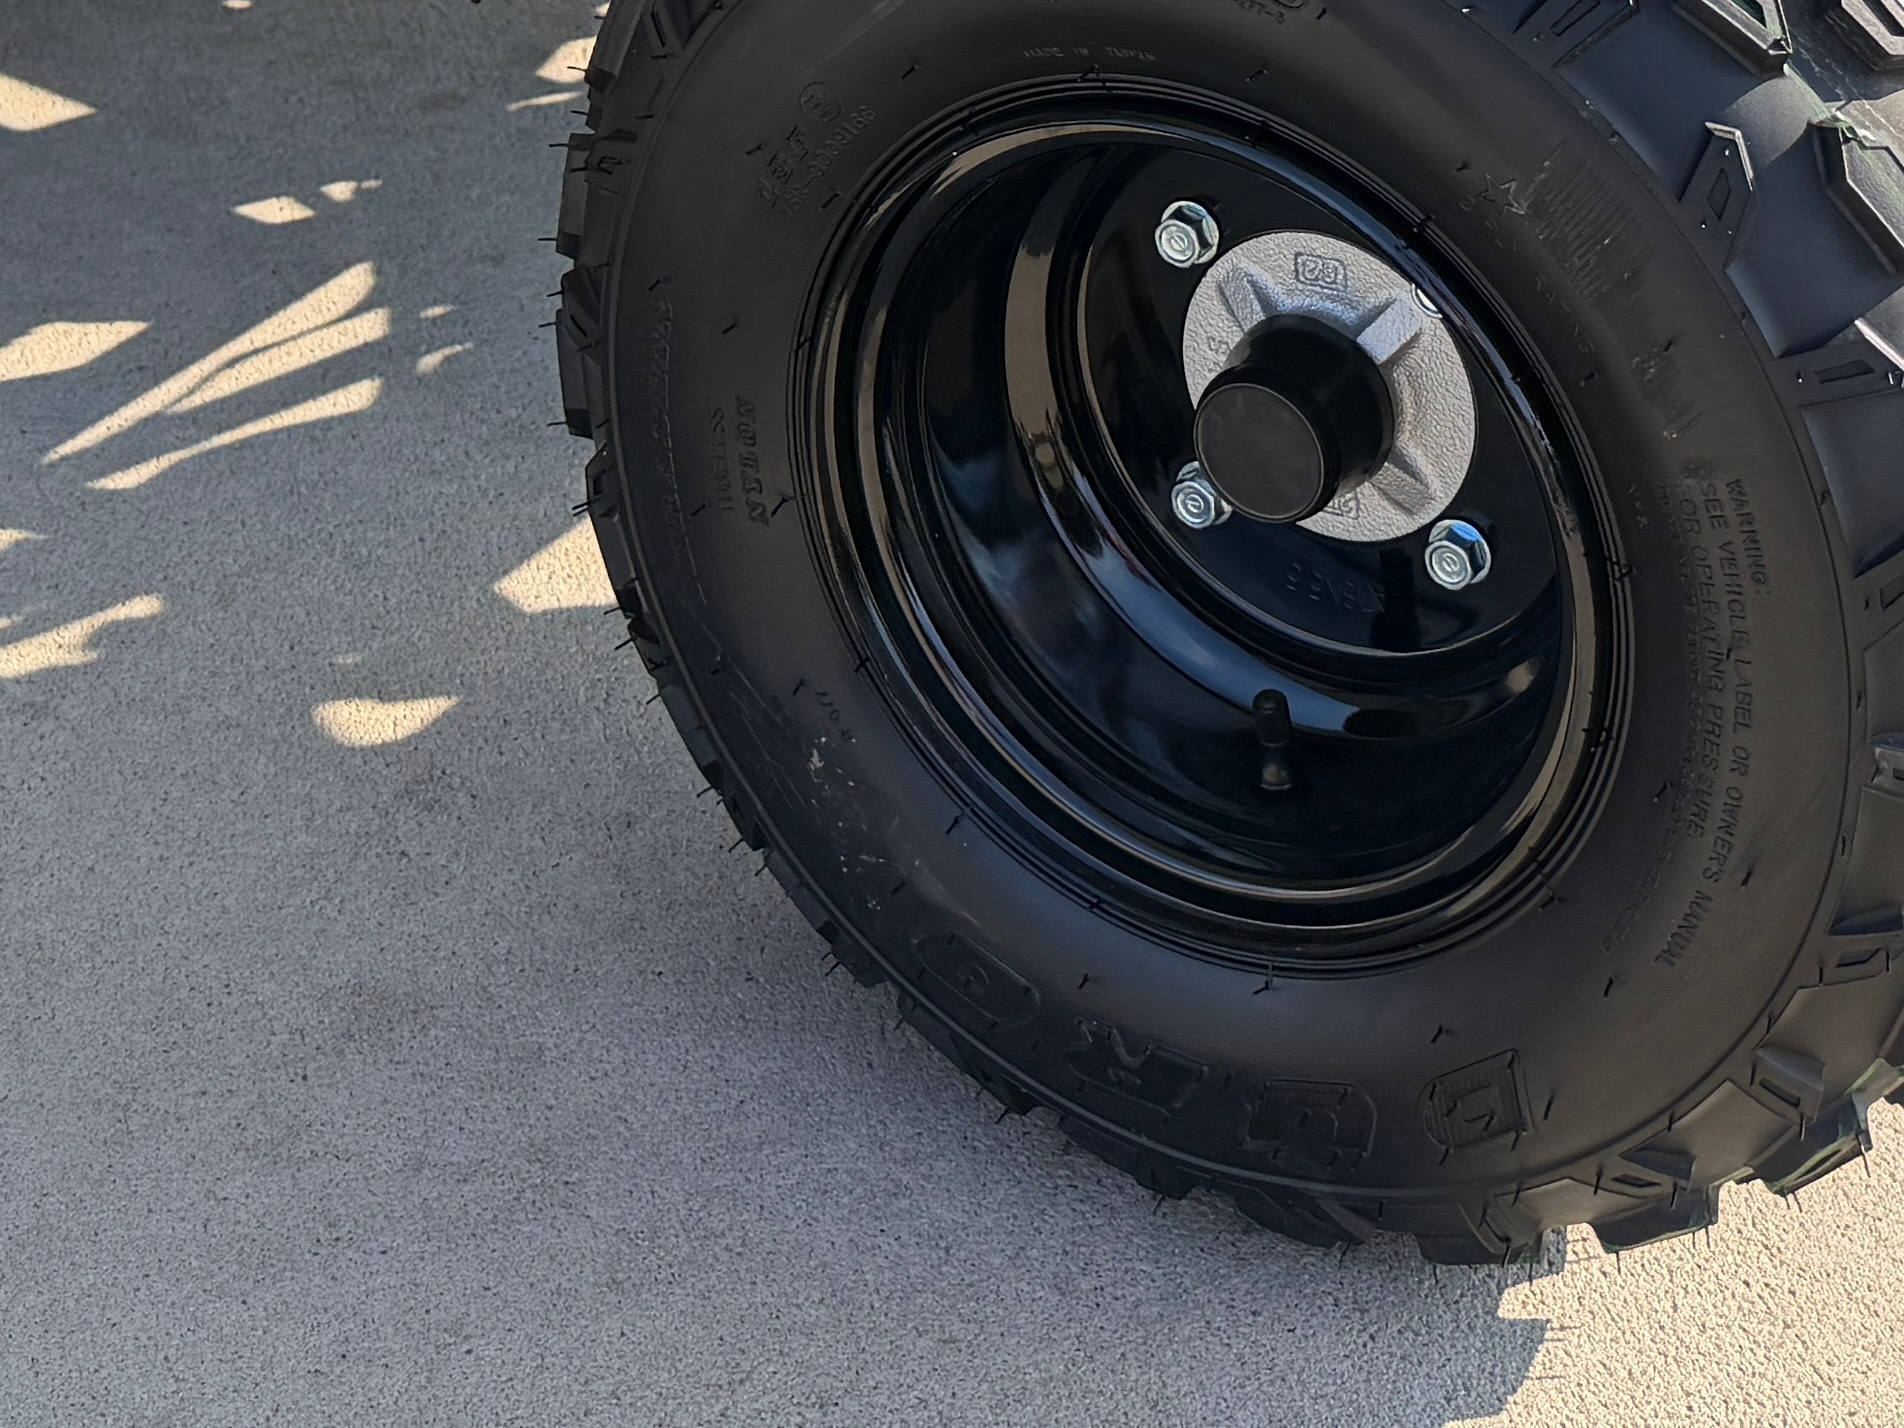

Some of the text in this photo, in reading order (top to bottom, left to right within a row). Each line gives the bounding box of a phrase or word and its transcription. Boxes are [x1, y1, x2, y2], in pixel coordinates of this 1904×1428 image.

[1726, 478, 1770, 596] WARNING:
[1689, 544, 1725, 692] OPERATING
[1653, 481, 1753, 970] SEE VEHICLE LABEL OR OWNER'S MANUAL
